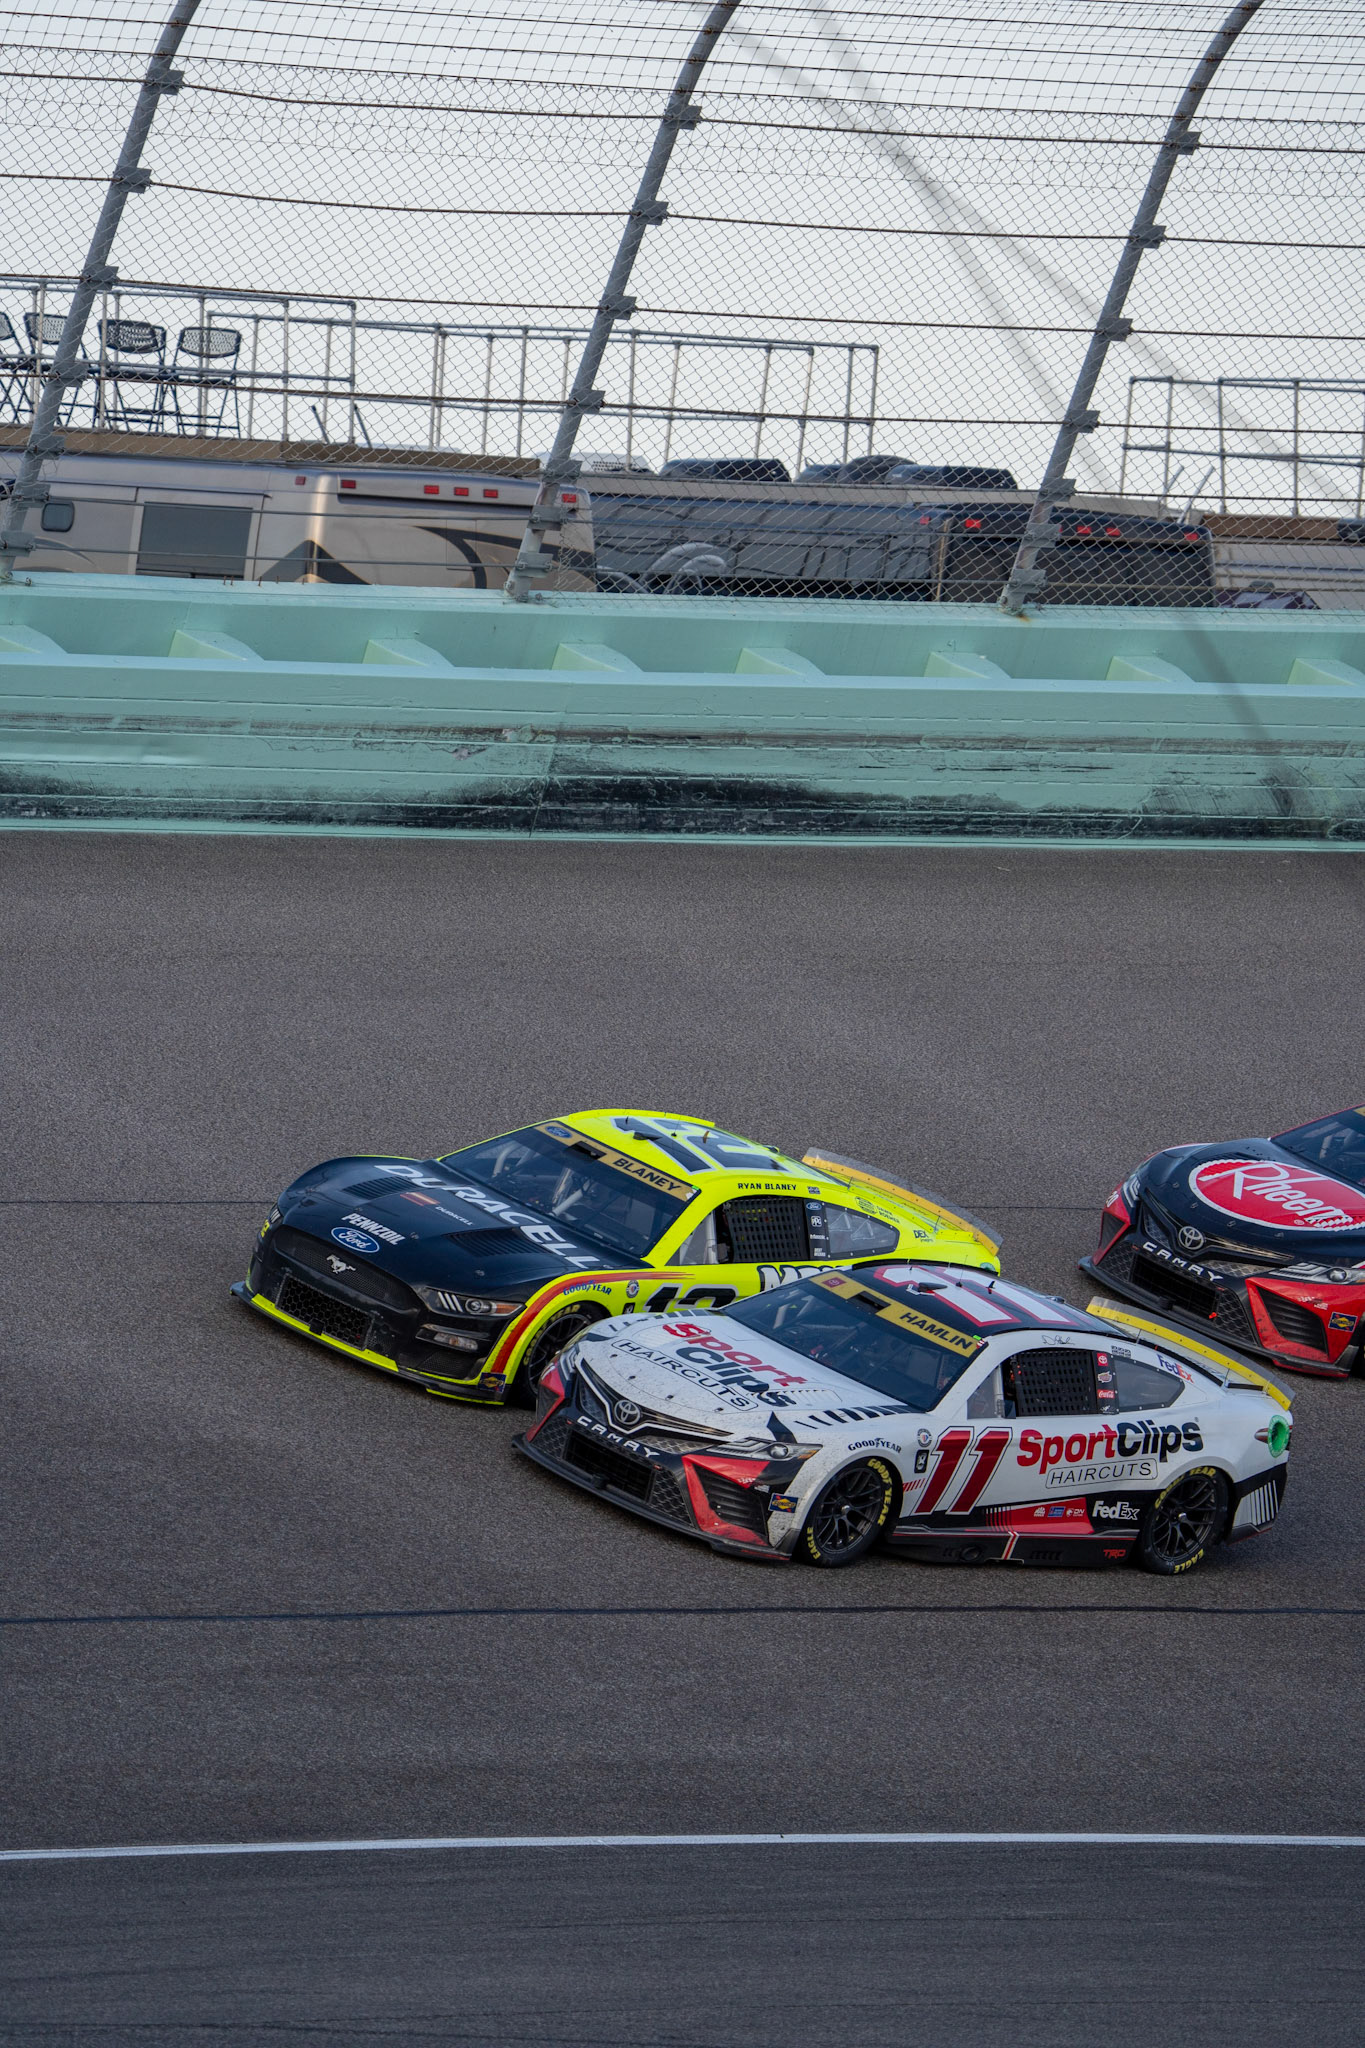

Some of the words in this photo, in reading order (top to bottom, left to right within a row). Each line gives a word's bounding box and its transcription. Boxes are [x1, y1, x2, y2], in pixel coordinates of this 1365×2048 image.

[609, 1116, 790, 1175] 12
[612, 1158, 682, 1191] BLANEY
[765, 1183, 797, 1191] BLANEY
[1197, 1163, 1353, 1227] Rheem
[341, 1212, 406, 1245] PENNZOIL
[374, 1165, 600, 1270] DURACELL
[435, 1206, 474, 1226] DURACELL
[338, 1230, 373, 1249] Ford
[1143, 1242, 1224, 1281] CAMRY
[874, 1265, 1078, 1327] 11
[900, 1313, 973, 1350] HAMLIN
[662, 1323, 808, 1387] Sport
[1156, 1353, 1195, 1385] FedEx
[618, 1341, 750, 1408] HAIRCUTS
[675, 1346, 797, 1408] Clips
[577, 1416, 660, 1458] CAMRY
[848, 1438, 902, 1454] GOODYEAR
[909, 1426, 1014, 1516] 11
[1050, 1462, 1152, 1485] HAIRCUTS
[1092, 1500, 1140, 1521] FedEx
[807, 1527, 821, 1560] EAGLE
[1103, 1549, 1126, 1559] TRD
[1173, 1549, 1204, 1574] EAGLE
